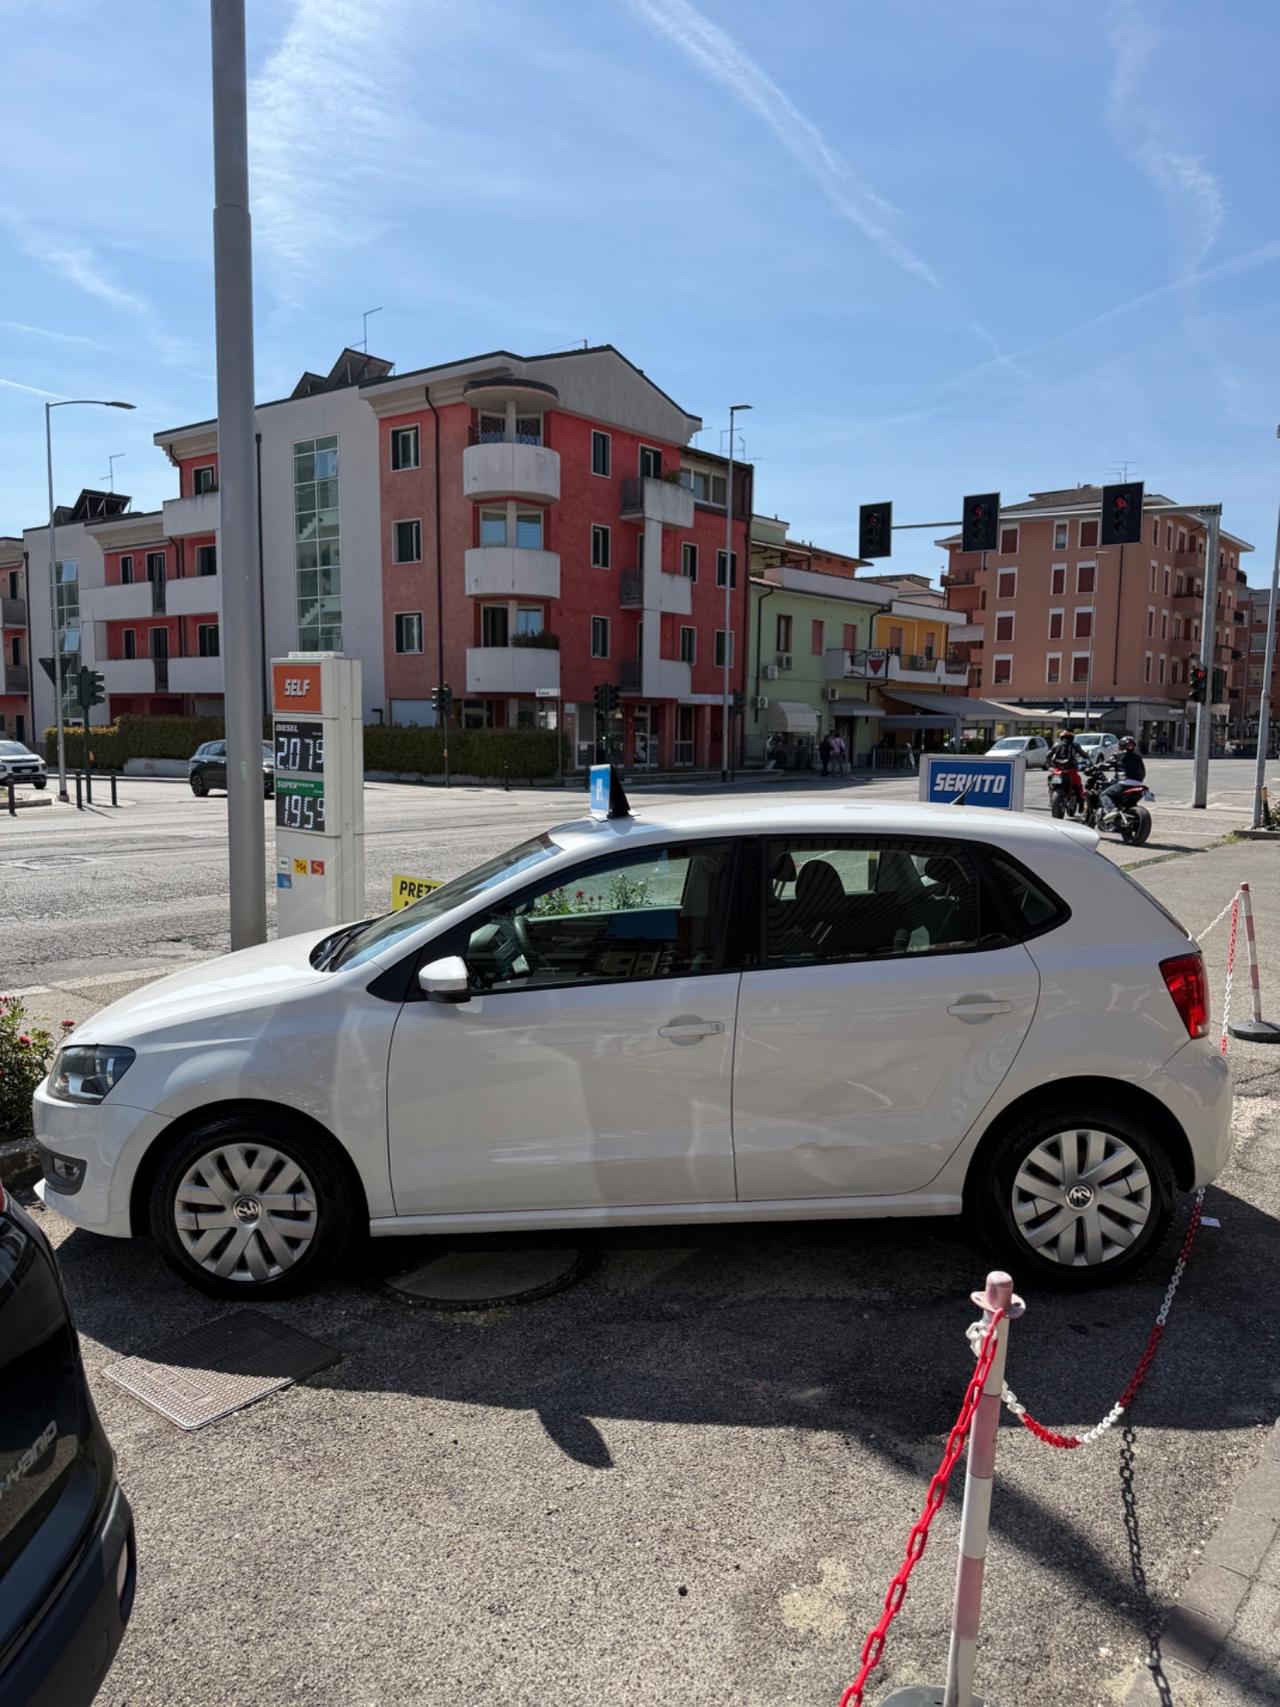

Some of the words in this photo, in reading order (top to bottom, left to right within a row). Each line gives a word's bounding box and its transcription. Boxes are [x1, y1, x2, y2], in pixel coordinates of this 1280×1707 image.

[284, 679, 310, 696] SELF
[275, 724, 298, 732] DIESEL
[277, 737, 325, 770] 2.079
[277, 780, 297, 788] SUPER
[934, 773, 1006, 793] SERVITO
[284, 795, 325, 828] 1.959
[399, 880, 438, 898] PREZ
